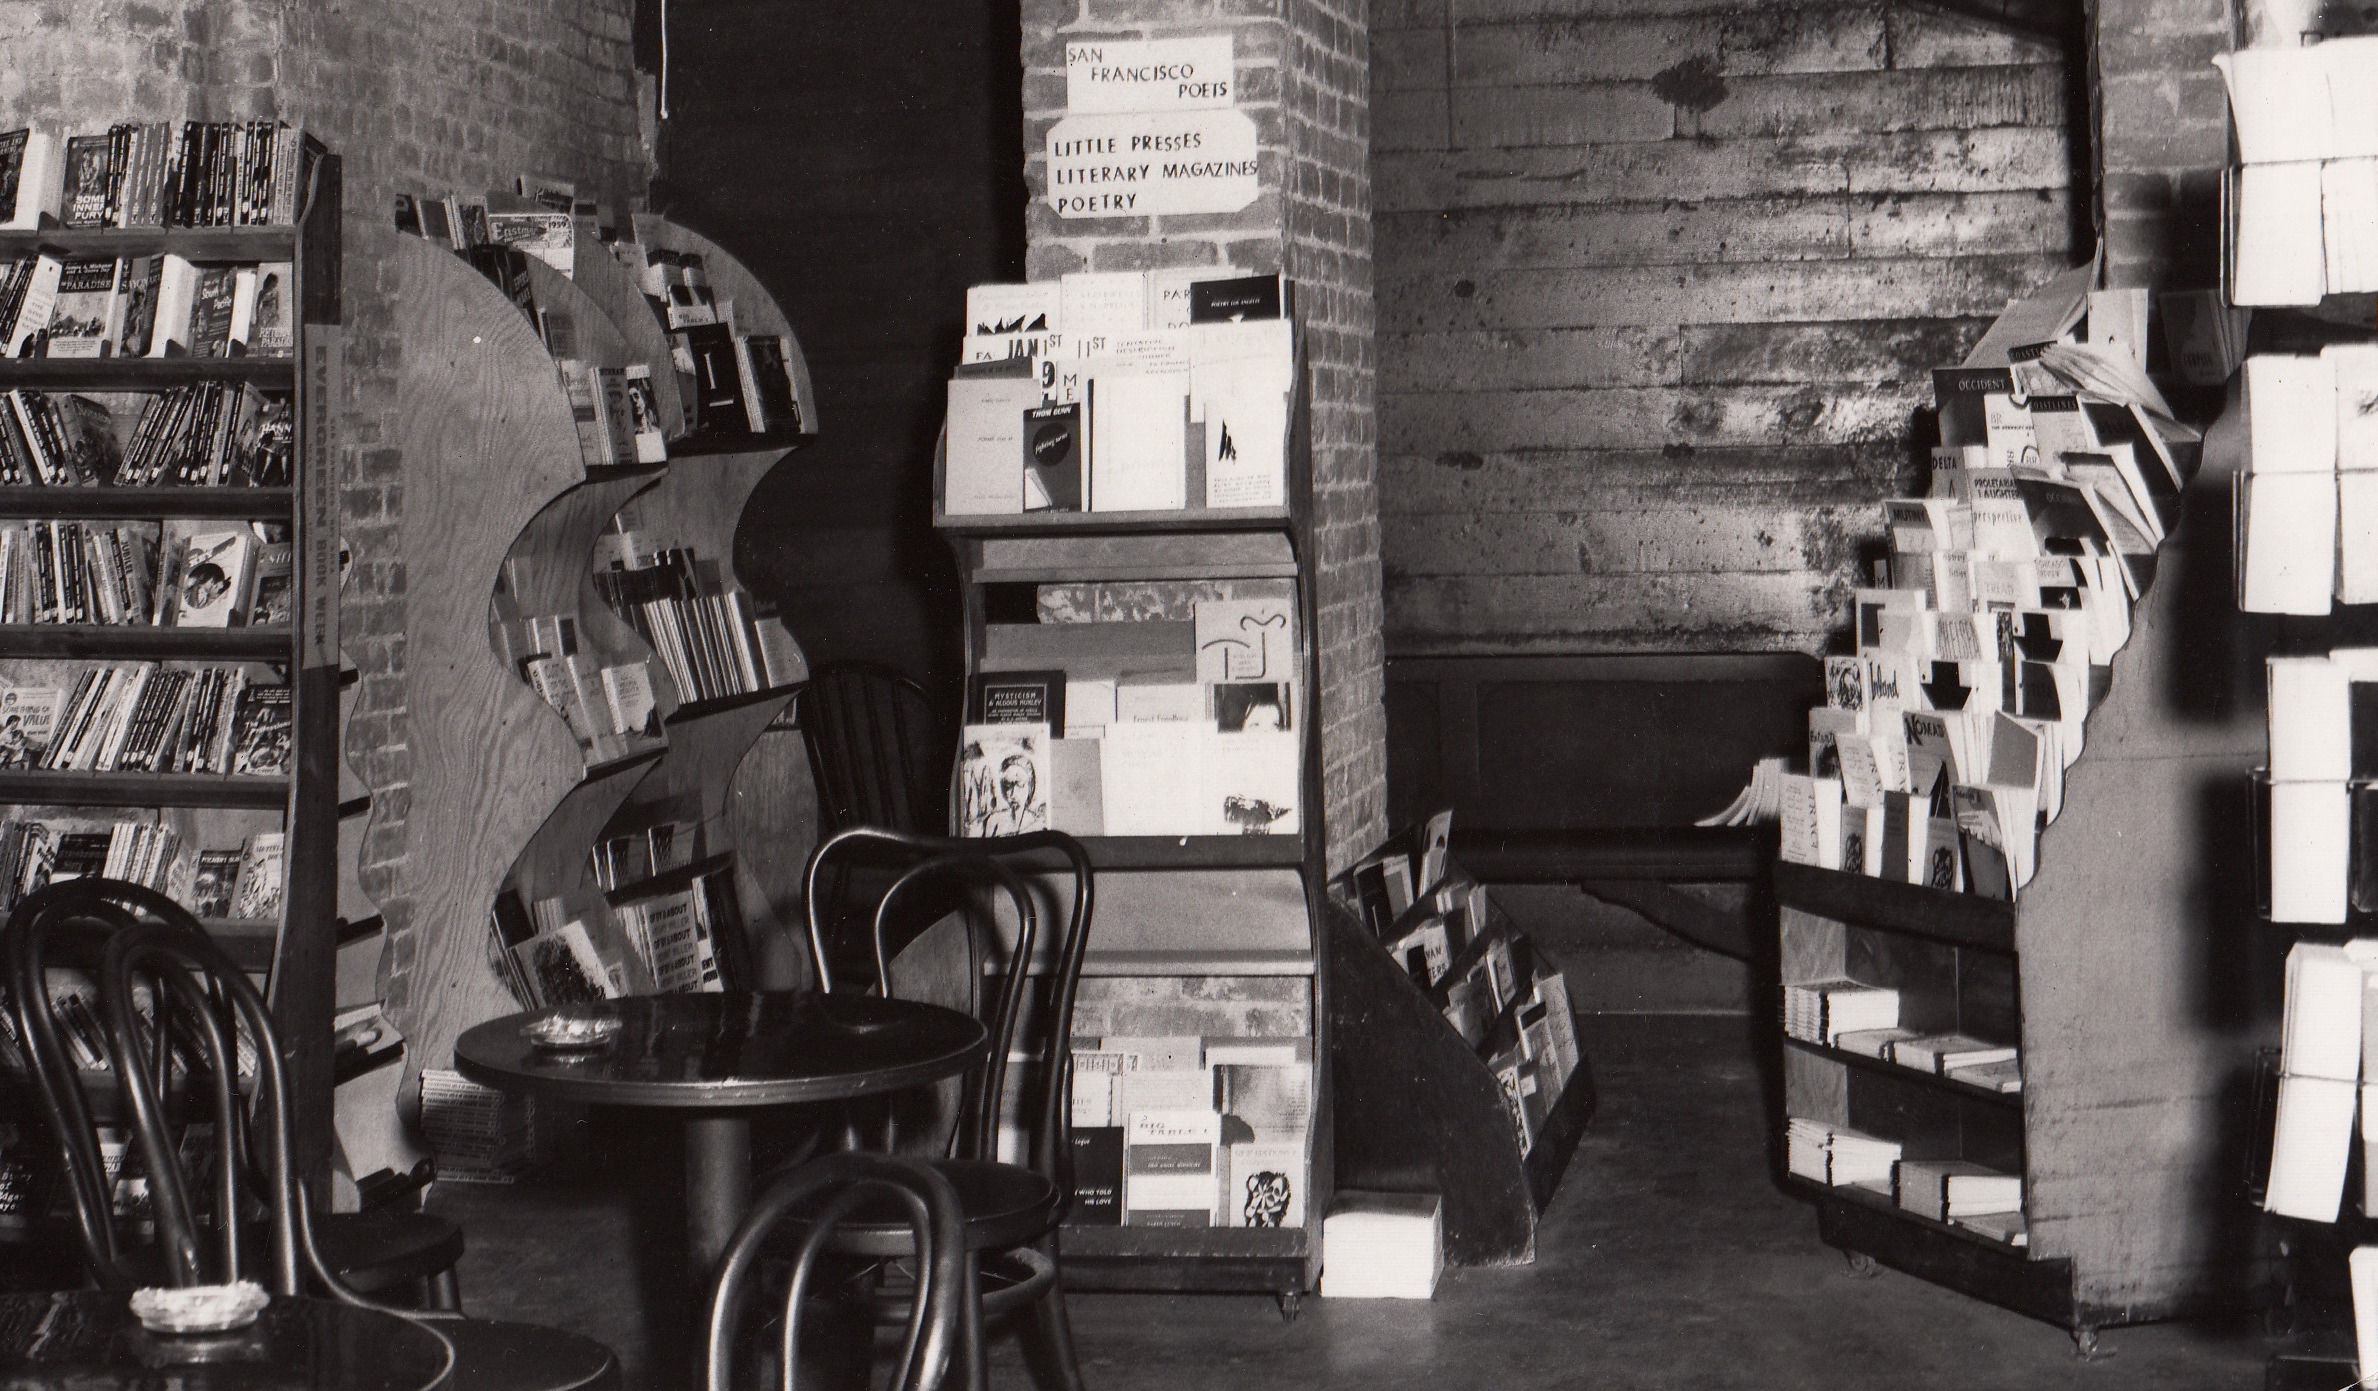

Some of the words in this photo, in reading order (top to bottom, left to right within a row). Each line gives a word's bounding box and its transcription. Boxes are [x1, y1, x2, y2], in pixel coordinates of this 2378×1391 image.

[1068, 48, 1103, 63] SAN
[1091, 64, 1194, 83] FRANCISCO
[1178, 82, 1227, 98] POETS
[1055, 138, 1116, 157] LITTLE
[1132, 133, 1201, 151] PRESSES
[1057, 165, 1149, 184] LITERARY
[1162, 161, 1258, 179] MAGAZINES
[76, 195, 105, 204] SOME
[1058, 194, 1137, 213] POETRY
[75, 212, 103, 220] FURY
[66, 280, 111, 290] PARADISE
[1008, 339, 1038, 359] JAN
[1958, 379, 2005, 390] OCCIDENT
[1032, 408, 1052, 418] THOM
[1053, 406, 1072, 416] GUNN
[1990, 414, 2002, 424] BR
[316, 346, 327, 528] EVERGREEN
[1932, 456, 1957, 470] DELTA
[1894, 509, 1924, 522] MUTINY
[1974, 510, 2022, 526] perspective
[121, 542, 134, 575] JUBILEE
[316, 540, 327, 587] BOOK
[315, 597, 325, 645] WEEK
[24, 714, 50, 726] VALUE
[1904, 714, 1945, 746] NOMAD
[668, 903, 687, 916] ABOUT
[670, 929, 690, 944] ABOUT
[674, 955, 694, 968] ABOUT
